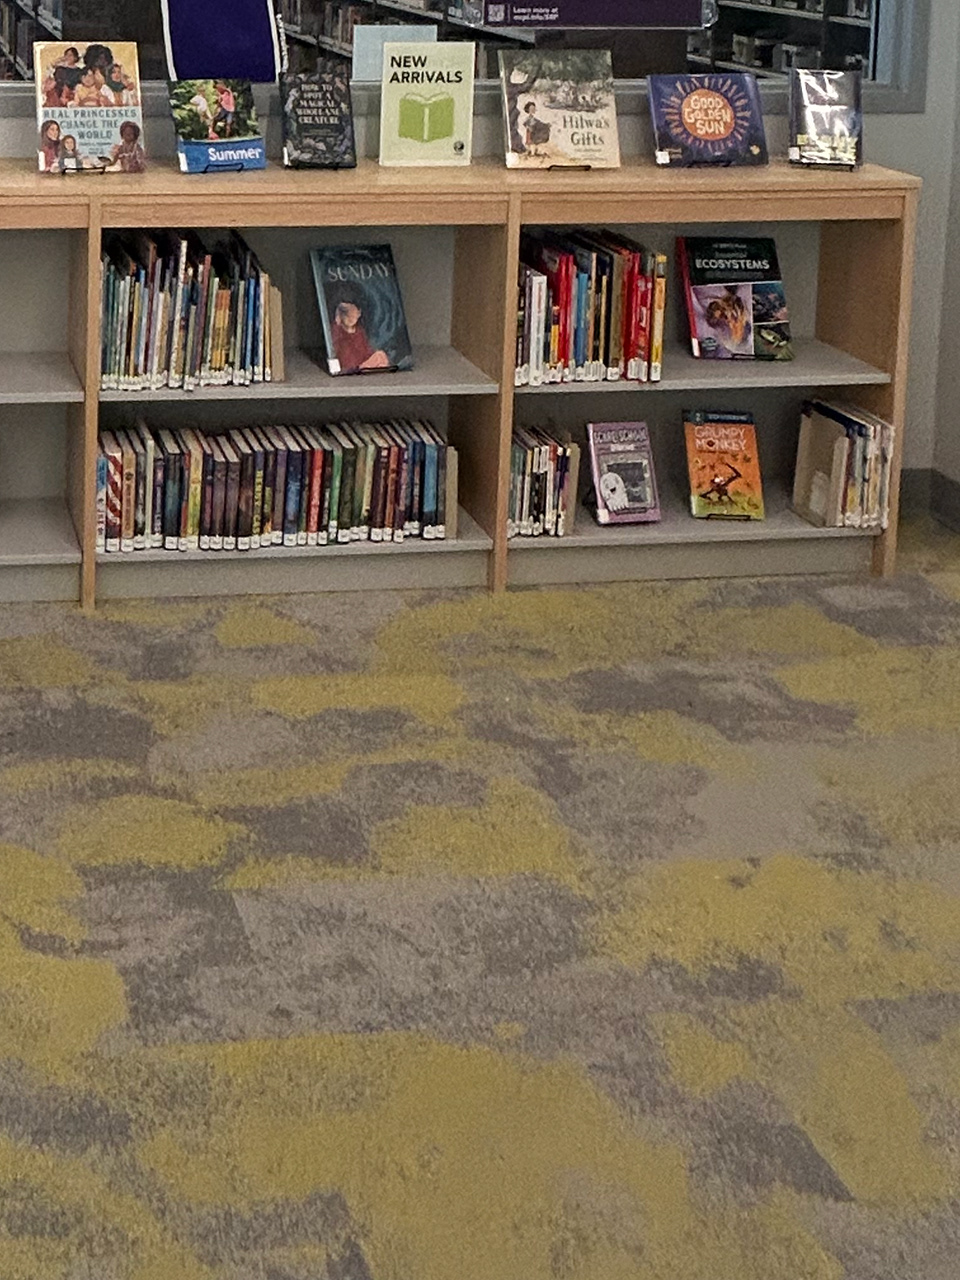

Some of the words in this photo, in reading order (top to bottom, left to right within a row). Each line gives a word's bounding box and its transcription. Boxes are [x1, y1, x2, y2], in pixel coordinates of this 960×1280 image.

[390, 55, 427, 68] NEW
[389, 71, 463, 84] ARRIVALS
[690, 94, 723, 109] GOOD
[43, 108, 70, 119] REAL
[73, 107, 138, 119] PRINCESSES
[684, 107, 732, 123] GOLDEN
[101, 119, 119, 129] THE
[562, 114, 610, 129] Hilwa's
[696, 121, 725, 135] SUN
[77, 130, 113, 140] WORLD
[570, 131, 605, 146] Gifts
[208, 147, 262, 162] Summer
[695, 258, 770, 270] ECOSYSTEMS
[327, 262, 390, 281] SUNDAY
[694, 425, 746, 440] GRUMPY
[694, 437, 747, 451] MONKEY
